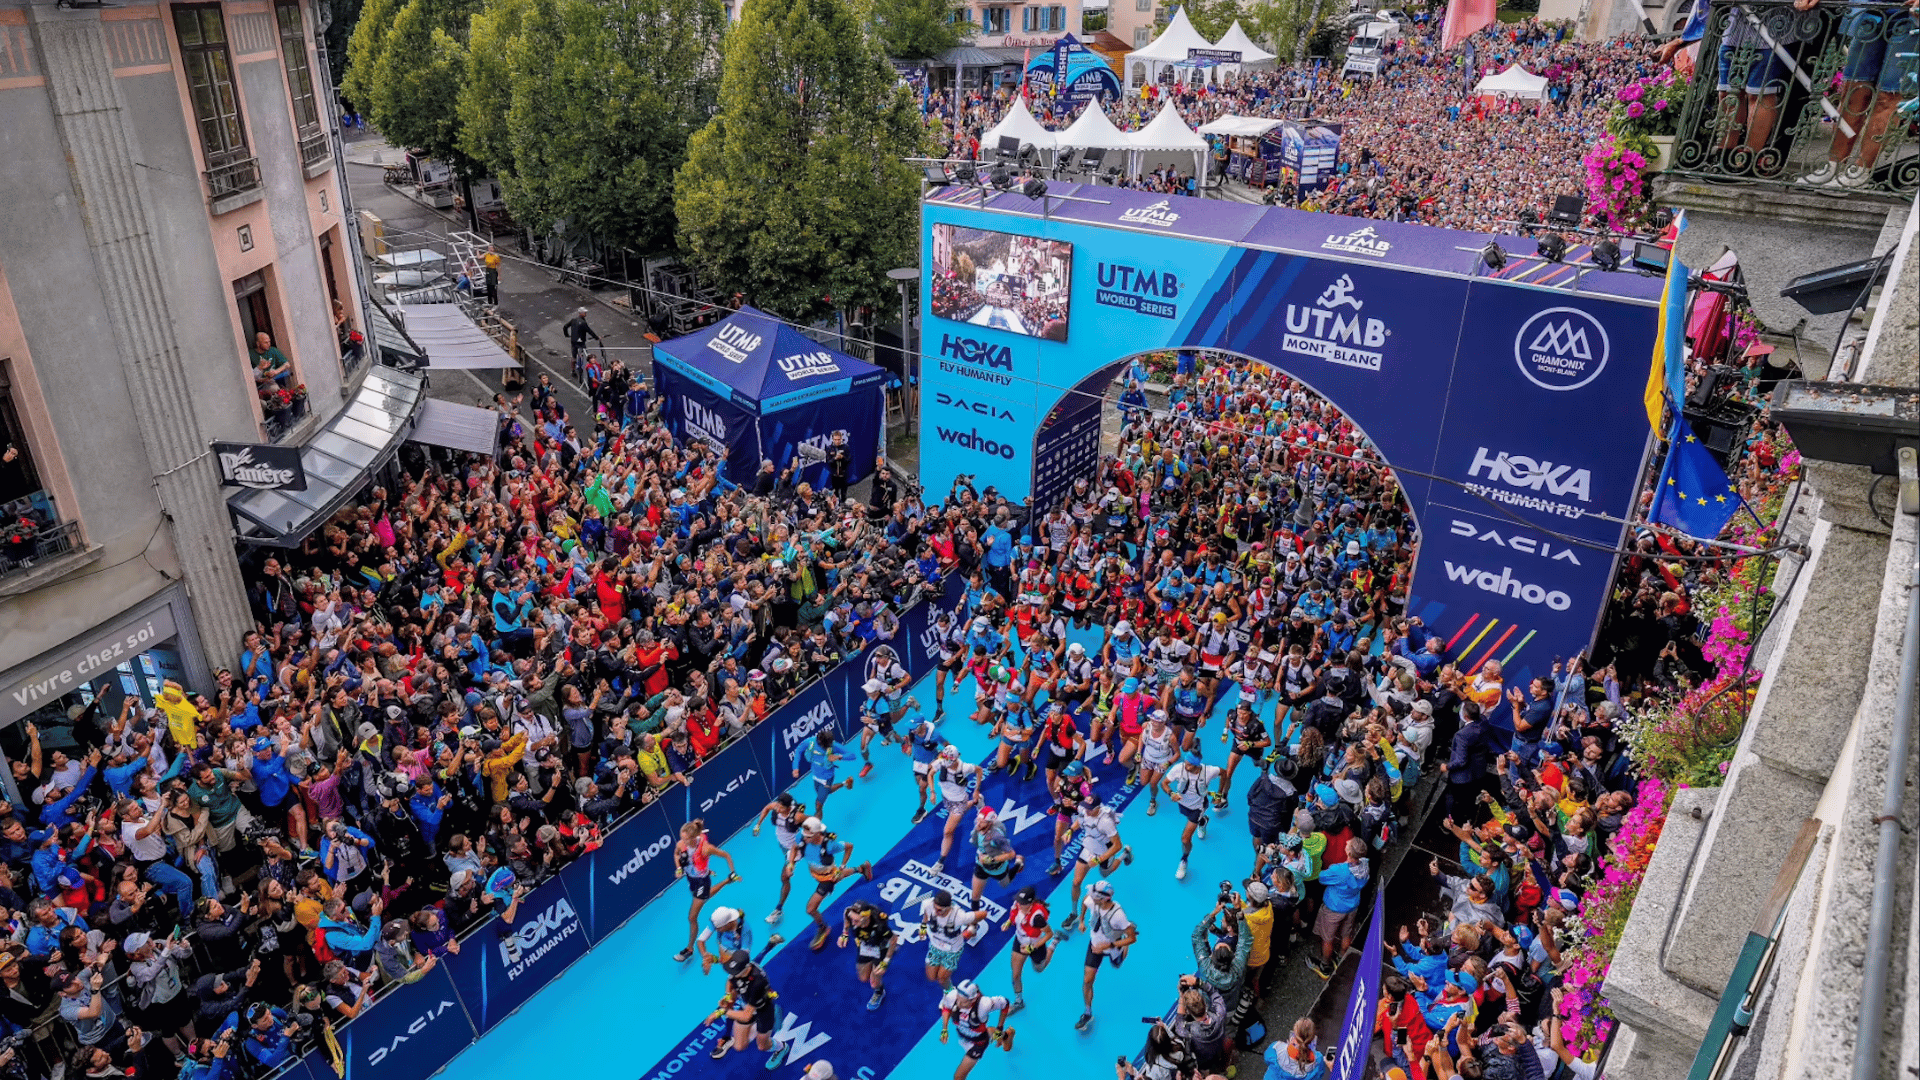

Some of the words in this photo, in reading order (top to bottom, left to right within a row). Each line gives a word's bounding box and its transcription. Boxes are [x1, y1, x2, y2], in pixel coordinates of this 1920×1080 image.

[1124, 208, 1179, 222] UTMB
[1326, 235, 1391, 251] UTMB
[1097, 262, 1179, 299] UTMB
[1099, 291, 1137, 307] WORLD
[1140, 302, 1174, 316] SERIES
[718, 322, 762, 352] UTMB
[1286, 304, 1386, 348] UTMB
[711, 340, 731, 353] WORLD
[728, 350, 745, 361] SERIES
[777, 351, 833, 372] UTMB
[940, 333, 1014, 372] HOKA
[1531, 353, 1586, 371] CHAMONIX
[790, 368, 815, 379] WORLD
[816, 365, 838, 374] SERIES
[939, 361, 955, 373] FLY
[956, 365, 994, 383] HUMAN
[996, 374, 1013, 386] FLY
[1537, 364, 1577, 377] MONT-BLANC
[682, 394, 726, 440] UTMB
[936, 392, 1016, 423] DACIA
[936, 425, 1015, 460] wahoo
[1467, 446, 1592, 502] HOKA
[1464, 482, 1490, 498] FLY
[1491, 488, 1555, 514] HUMAN
[1556, 503, 1586, 520] FLY
[1450, 519, 1581, 566] DACIA
[1443, 560, 1572, 611] wahoo
[920, 610, 958, 649] UTB
[12, 669, 73, 707] Vivre
[77, 641, 124, 675] chez
[126, 621, 156, 649] soi
[782, 699, 833, 750] HOKA
[699, 768, 758, 813] DACIA
[608, 834, 672, 885] wahoo
[507, 961, 524, 982] FLY
[524, 934, 564, 967] HUMAN
[562, 919, 580, 939] FLY
[367, 1000, 455, 1067] DACIA
